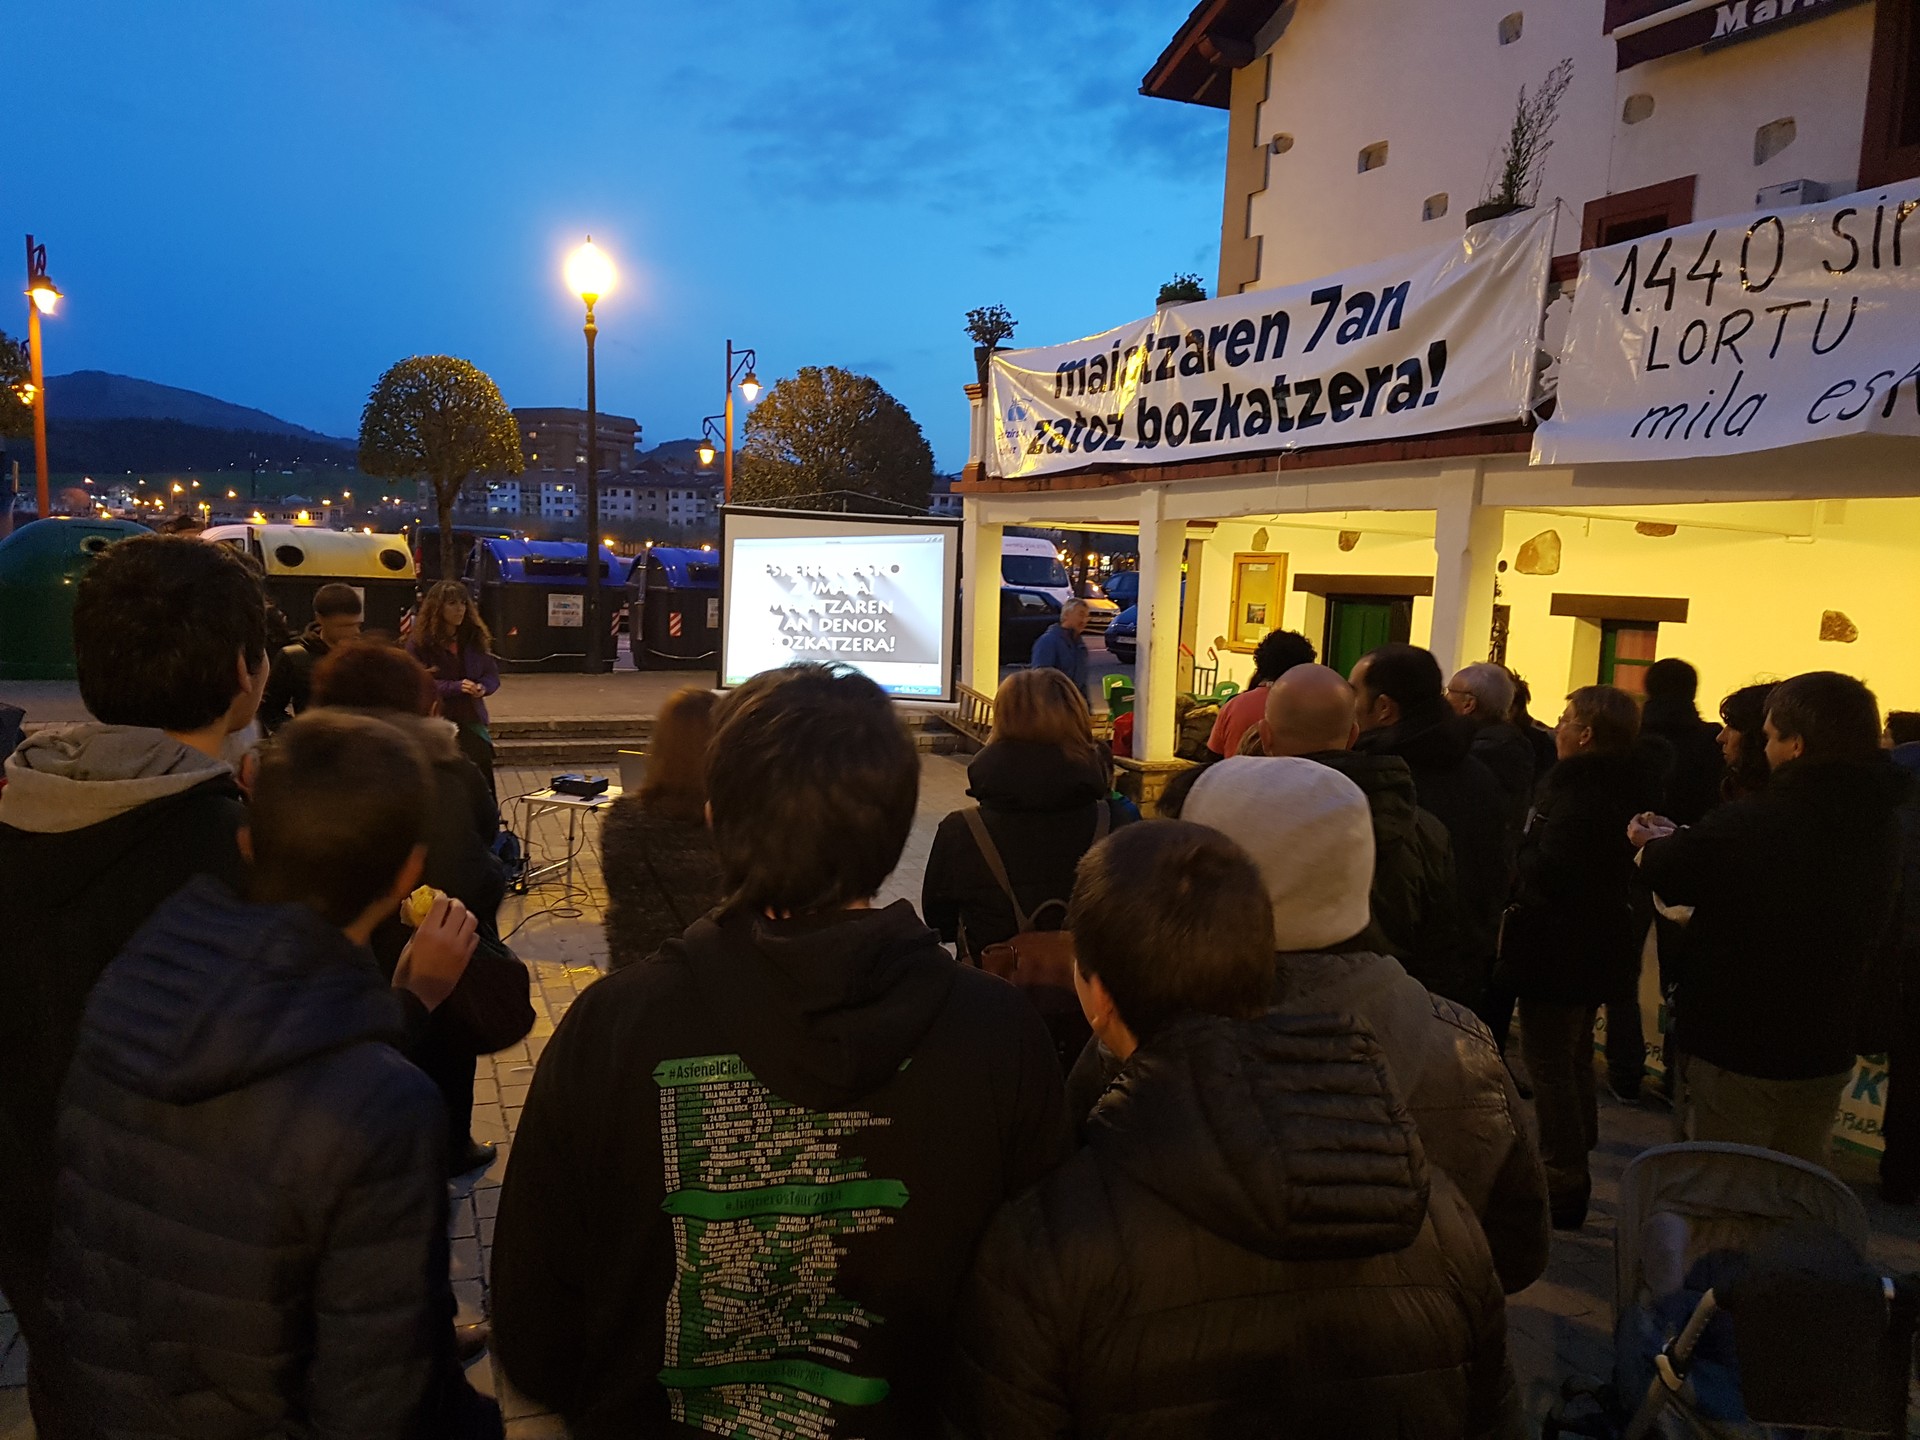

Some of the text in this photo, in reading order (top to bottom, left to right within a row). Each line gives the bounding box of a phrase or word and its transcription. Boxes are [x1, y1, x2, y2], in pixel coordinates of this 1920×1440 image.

[1614, 215, 1785, 315] 1.440
[1054, 281, 1411, 399] maiatzaren 7an
[1646, 297, 1858, 371] LORTU
[1027, 340, 1447, 455] zatoz bozkatzera!
[1630, 370, 1767, 440] mila
[769, 599, 894, 615] MAATZAREN
[818, 617, 887, 633] DENOK
[772, 635, 896, 652] OZKATZERA!
